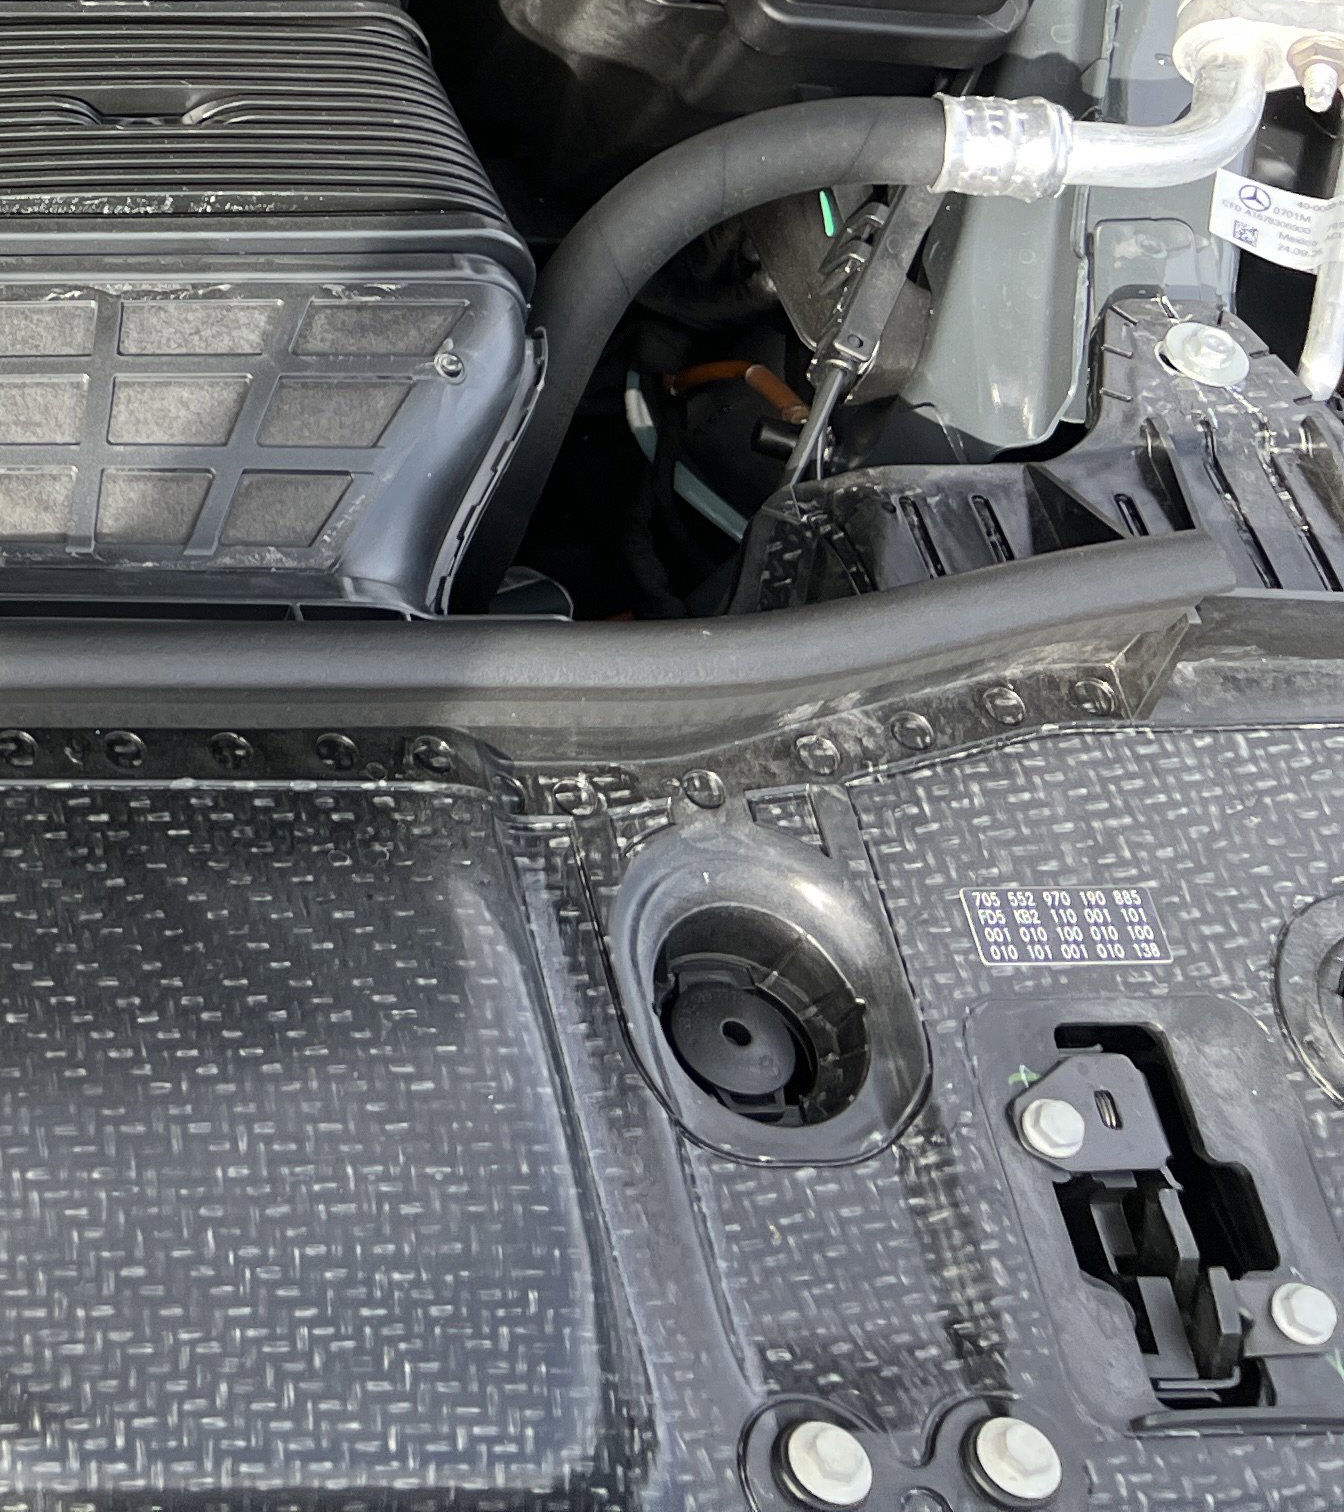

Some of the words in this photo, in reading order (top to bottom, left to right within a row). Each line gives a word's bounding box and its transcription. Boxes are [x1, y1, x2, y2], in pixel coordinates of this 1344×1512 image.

[971, 891, 1001, 907] 705
[1007, 891, 1036, 907] 552
[1043, 890, 1071, 907] 970
[1079, 890, 1106, 906] 190
[1113, 889, 1142, 906] 885
[977, 908, 1006, 926] FD5
[1013, 909, 1041, 925] KB2
[1050, 908, 1077, 925] 110
[1084, 908, 1112, 924] 001
[1120, 907, 1147, 923] 101
[984, 927, 1012, 943] 001
[1019, 927, 1048, 943] 010
[1056, 927, 1083, 942] 100
[1090, 926, 1119, 942] 010
[1127, 924, 1154, 941] 100
[990, 944, 1019, 961] 010
[1026, 944, 1053, 960] 101
[1061, 943, 1088, 960] 001
[1096, 943, 1125, 959] 010
[1133, 942, 1161, 959] 138
